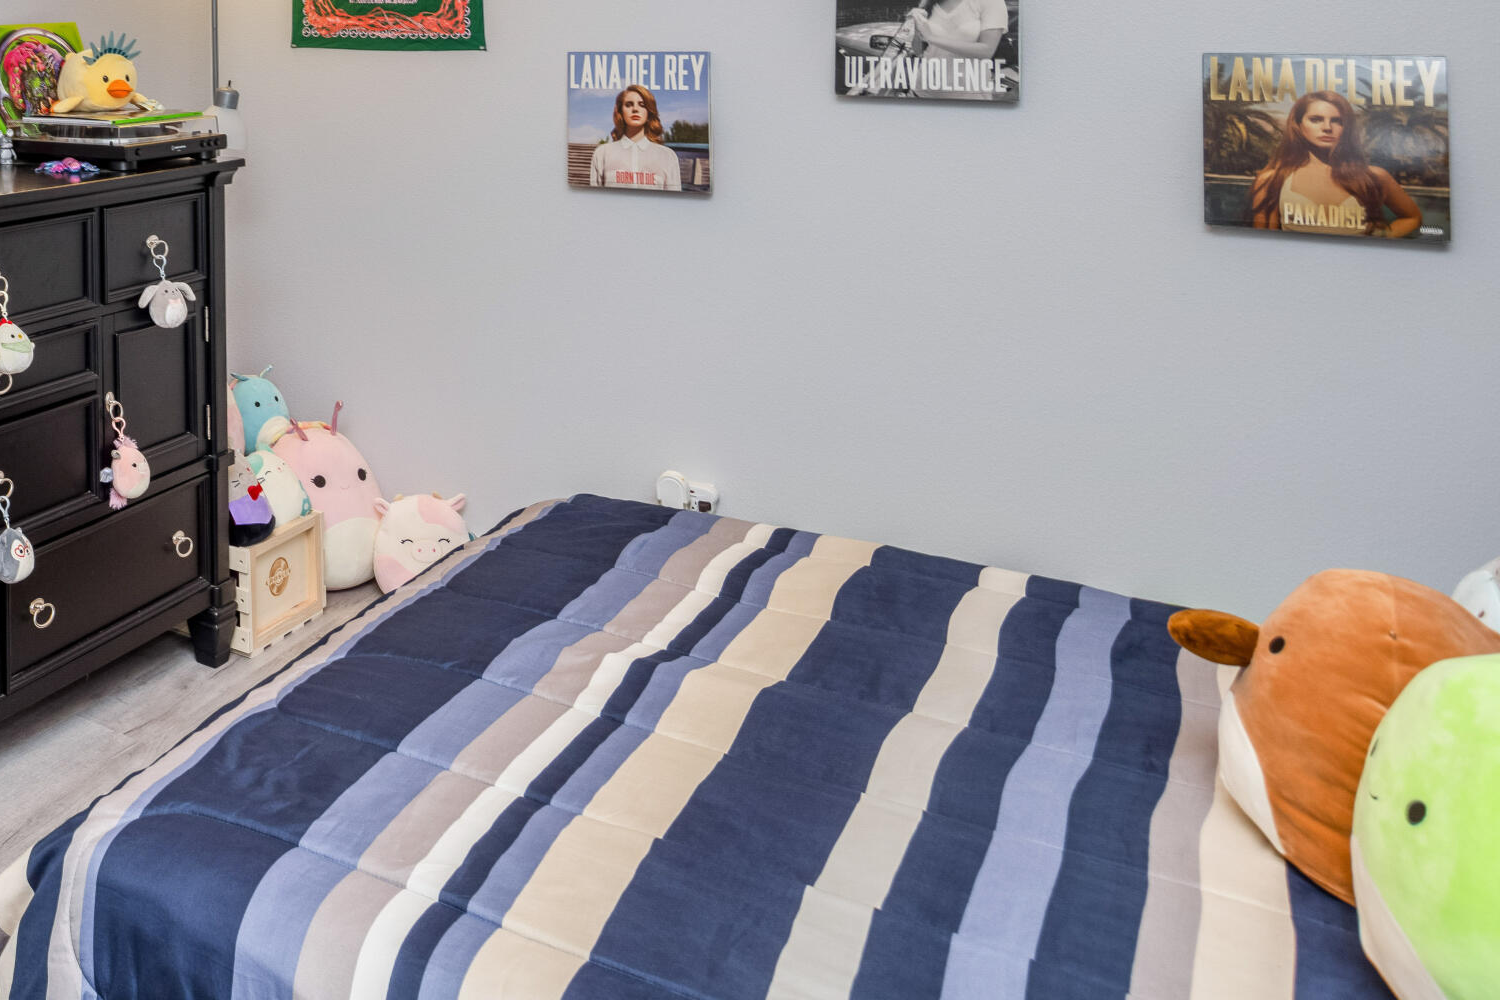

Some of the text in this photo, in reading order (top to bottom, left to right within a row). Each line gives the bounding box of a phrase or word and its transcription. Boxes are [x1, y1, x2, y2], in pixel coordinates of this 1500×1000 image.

[570, 54, 706, 91] LANA DEL REY
[844, 56, 1008, 93] ULTRAVIOLENCE
[1210, 56, 1441, 108] LANA DEL REY
[616, 170, 656, 186] BORN TO DIE
[1283, 202, 1367, 230] PARADISE
